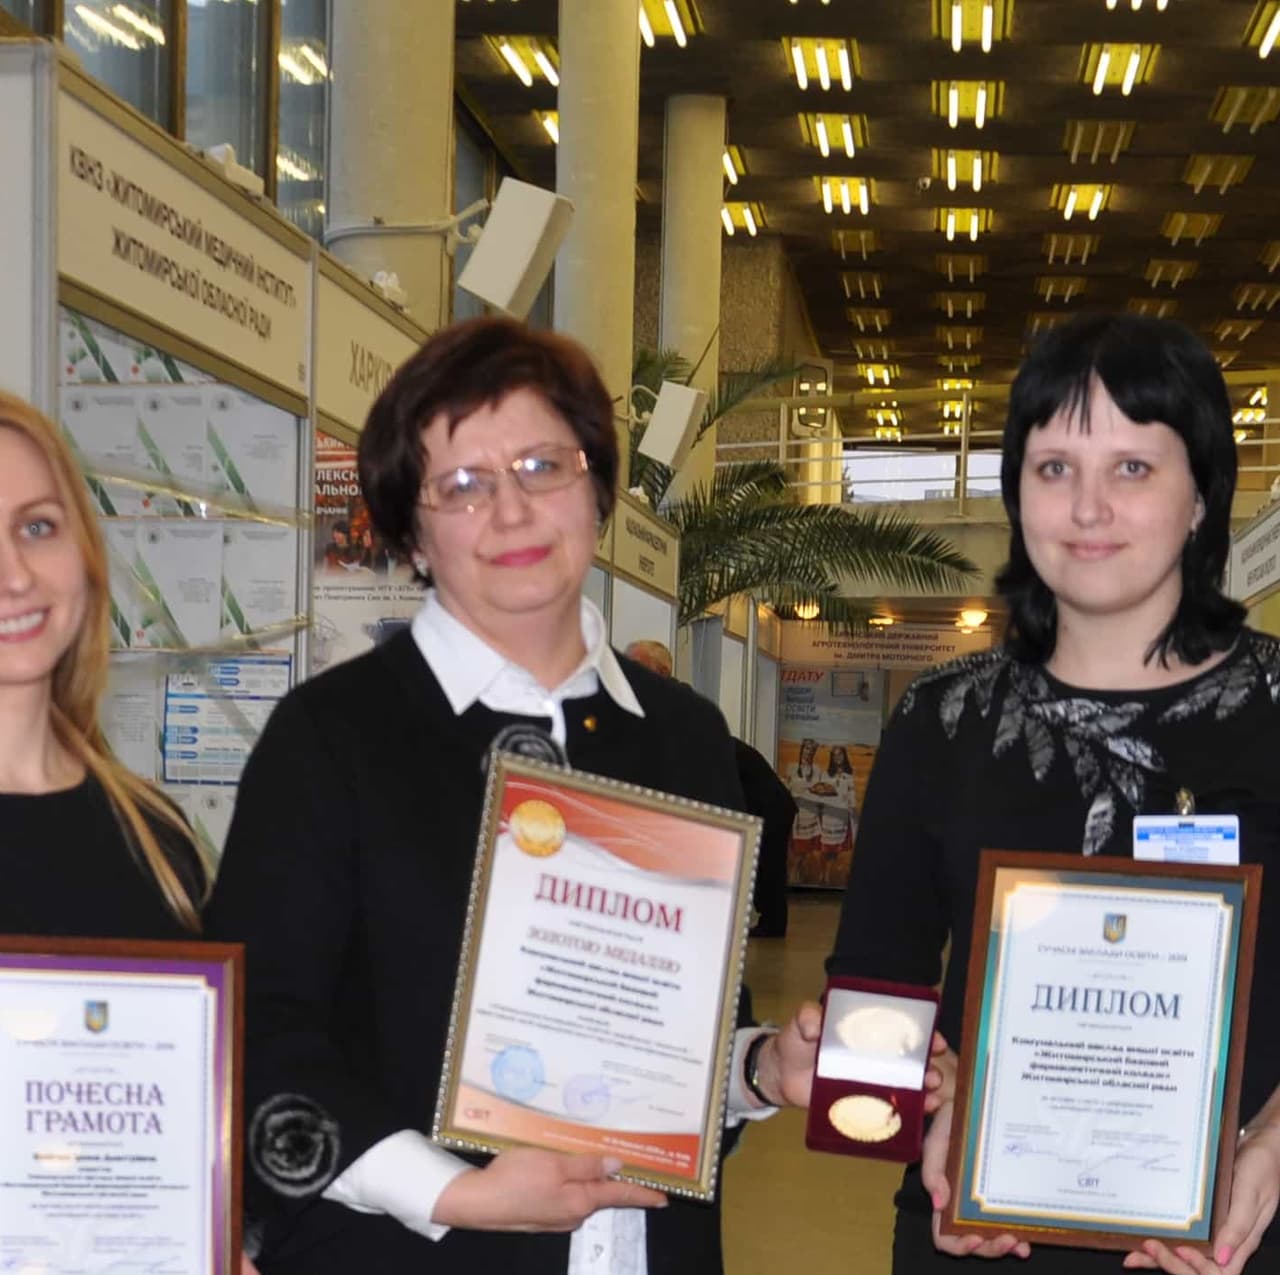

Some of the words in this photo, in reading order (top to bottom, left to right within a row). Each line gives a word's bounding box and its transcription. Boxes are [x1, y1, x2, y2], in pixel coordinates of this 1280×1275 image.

[534, 872, 683, 934] ДИПЛОМ
[1030, 983, 1183, 1021] ДИПЛОМ
[25, 1079, 165, 1107] ПОЧЕСНА
[25, 1109, 164, 1135] ГРАМОТА
